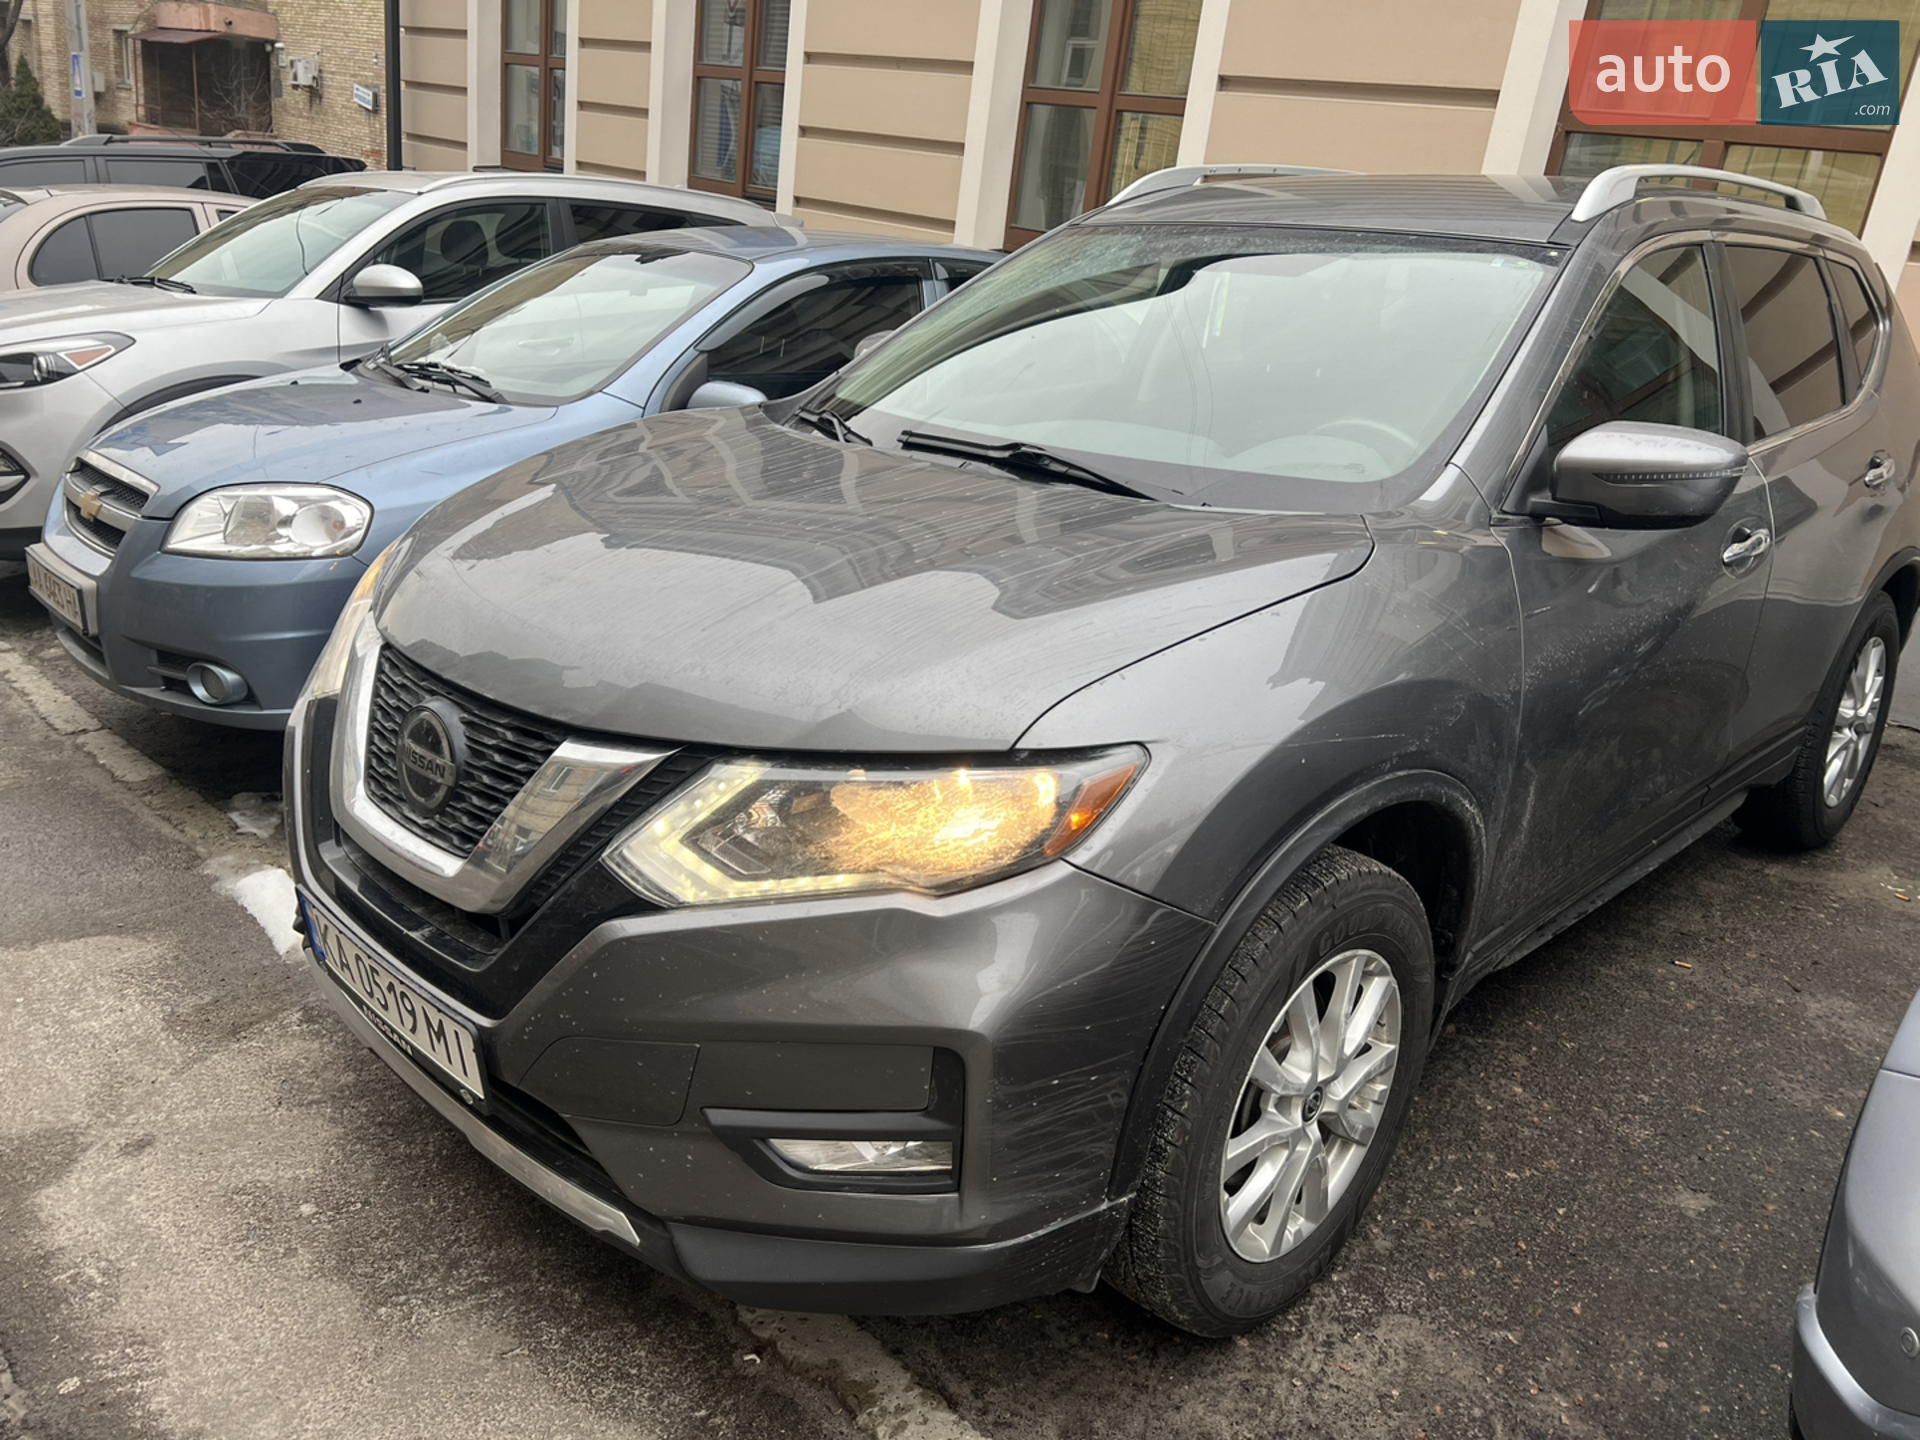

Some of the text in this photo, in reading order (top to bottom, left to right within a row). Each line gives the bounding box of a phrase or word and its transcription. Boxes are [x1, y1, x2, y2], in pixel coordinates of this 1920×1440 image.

[403, 744, 447, 779] NISSAN
[355, 952, 418, 1036] 0519
[422, 1005, 469, 1078] MI
